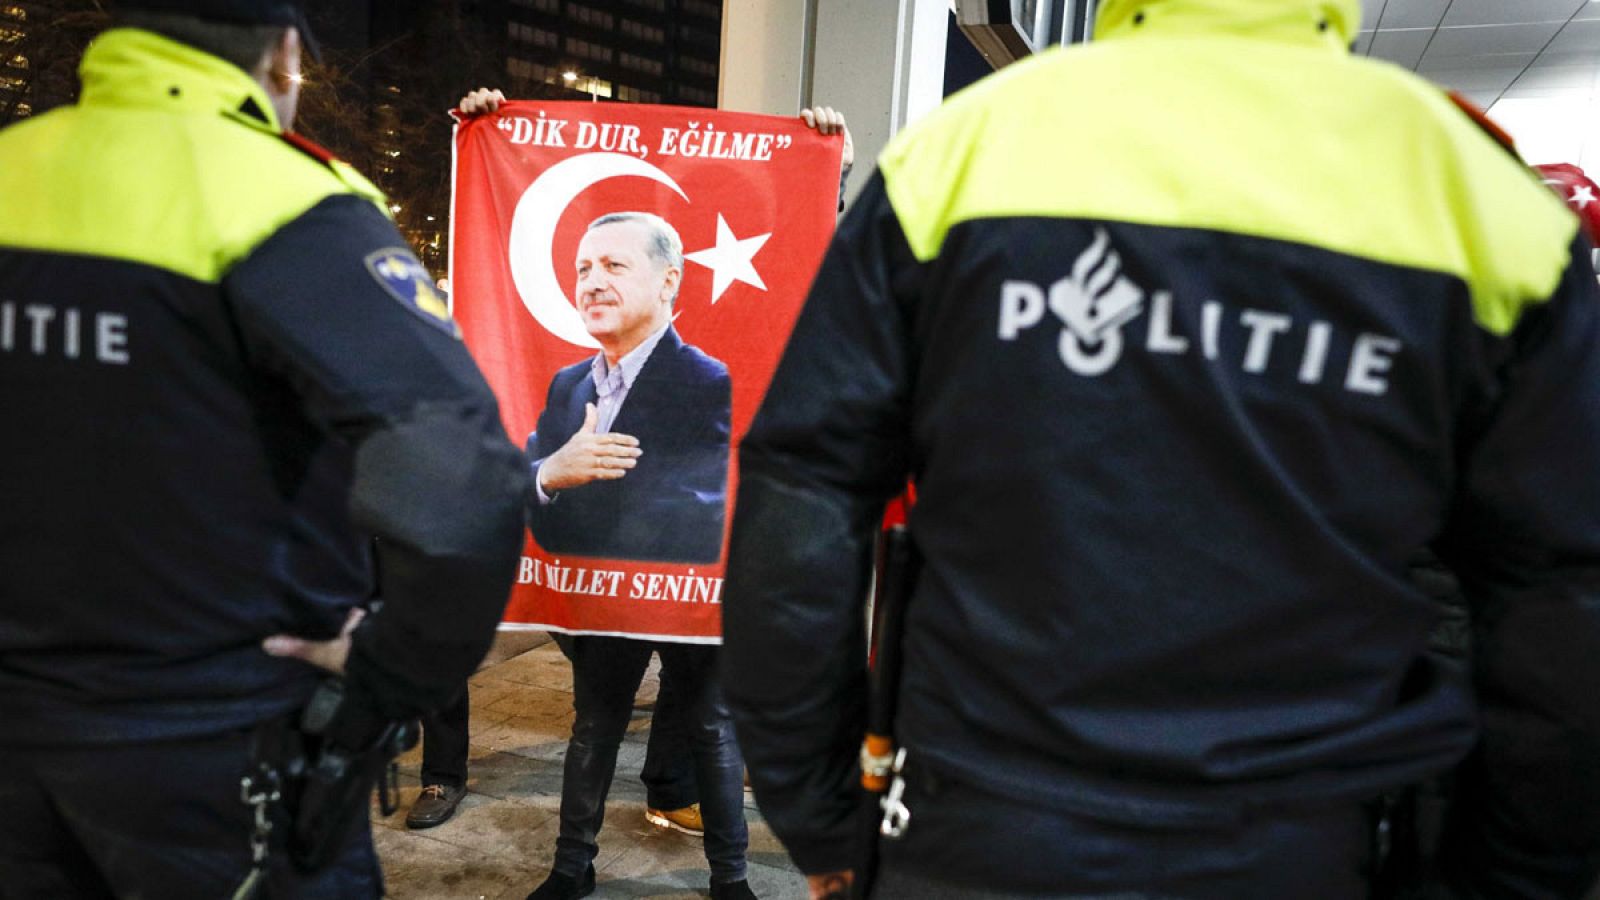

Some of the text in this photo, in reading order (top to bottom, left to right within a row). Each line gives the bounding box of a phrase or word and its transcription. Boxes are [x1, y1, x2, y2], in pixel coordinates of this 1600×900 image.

[497, 111, 792, 161] “DİK DUR, EĞİLME”
[517, 556, 543, 586] BU
